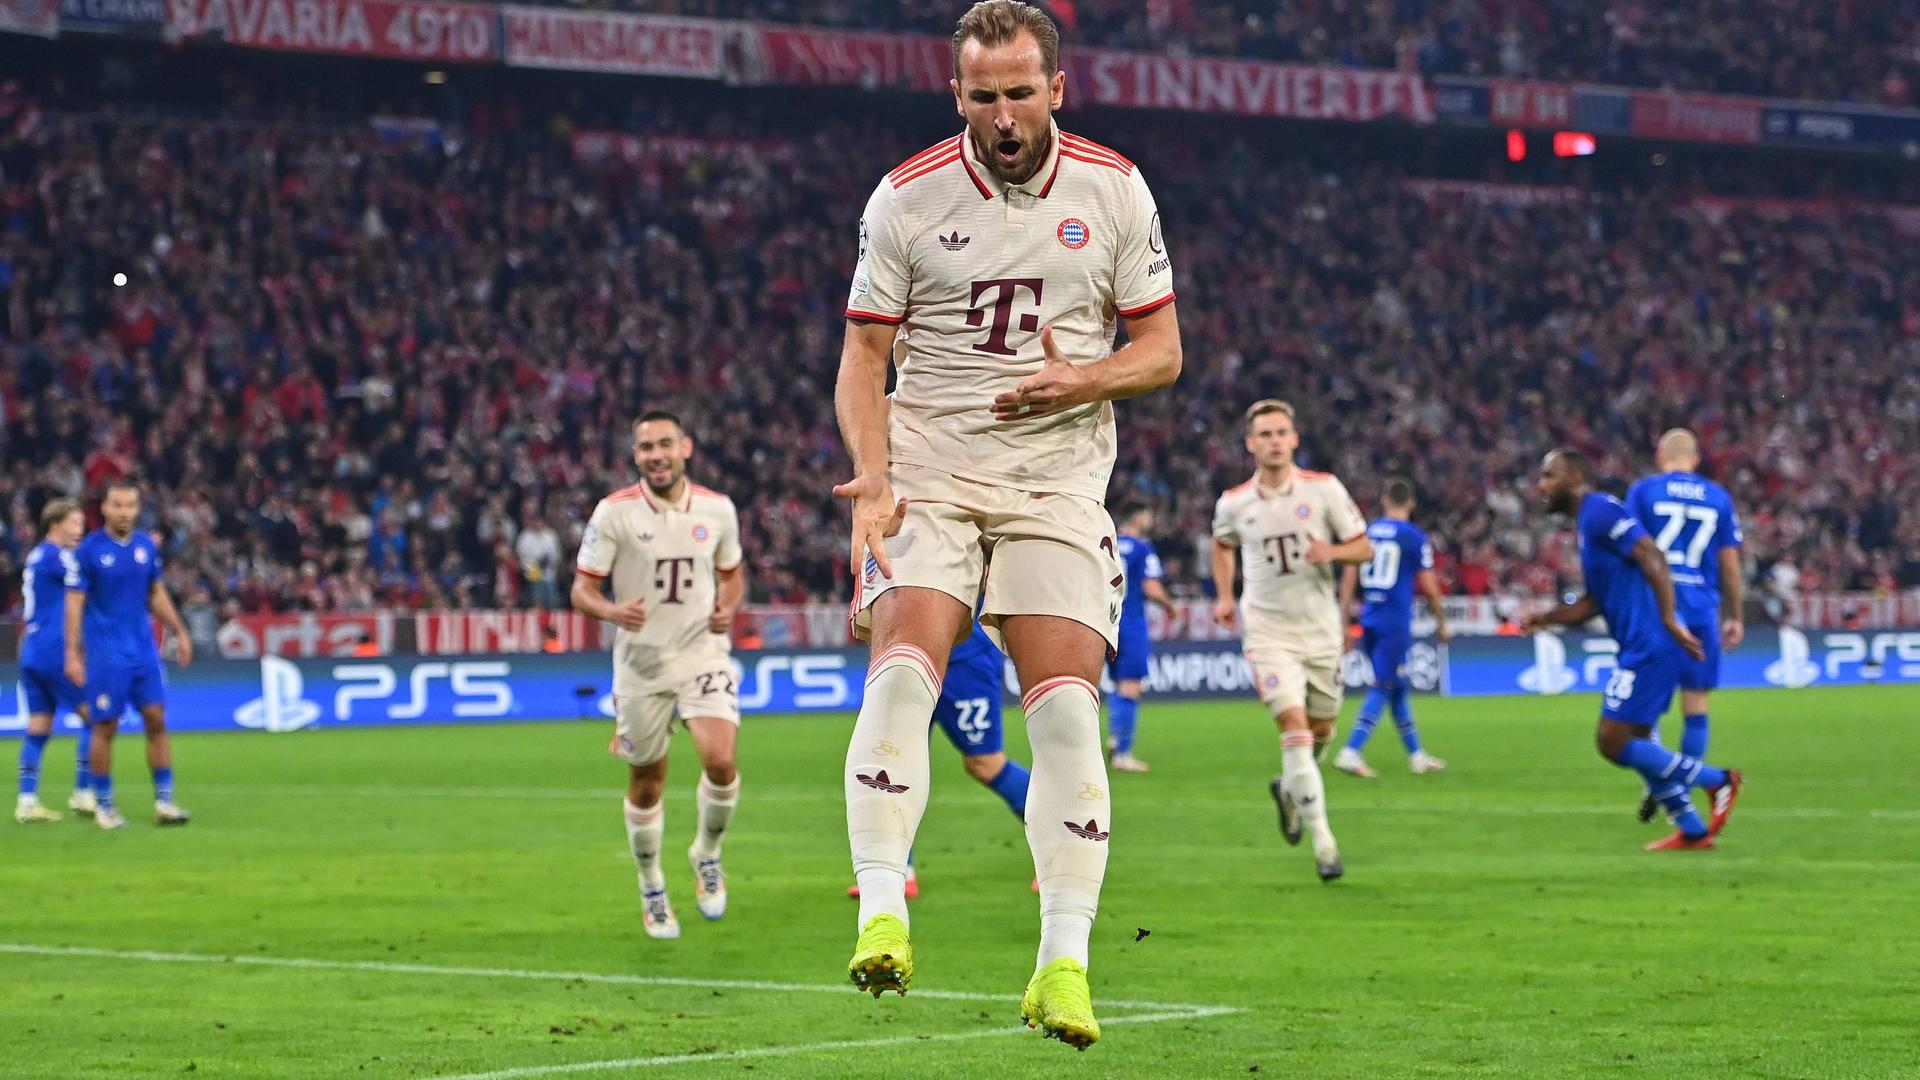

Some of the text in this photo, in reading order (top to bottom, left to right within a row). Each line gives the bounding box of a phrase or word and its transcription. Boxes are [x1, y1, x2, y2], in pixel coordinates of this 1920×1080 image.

[385, 9, 490, 57] 4910
[332, 661, 514, 721] PS5
[732, 654, 848, 709] S5
[954, 697, 992, 731] 22
